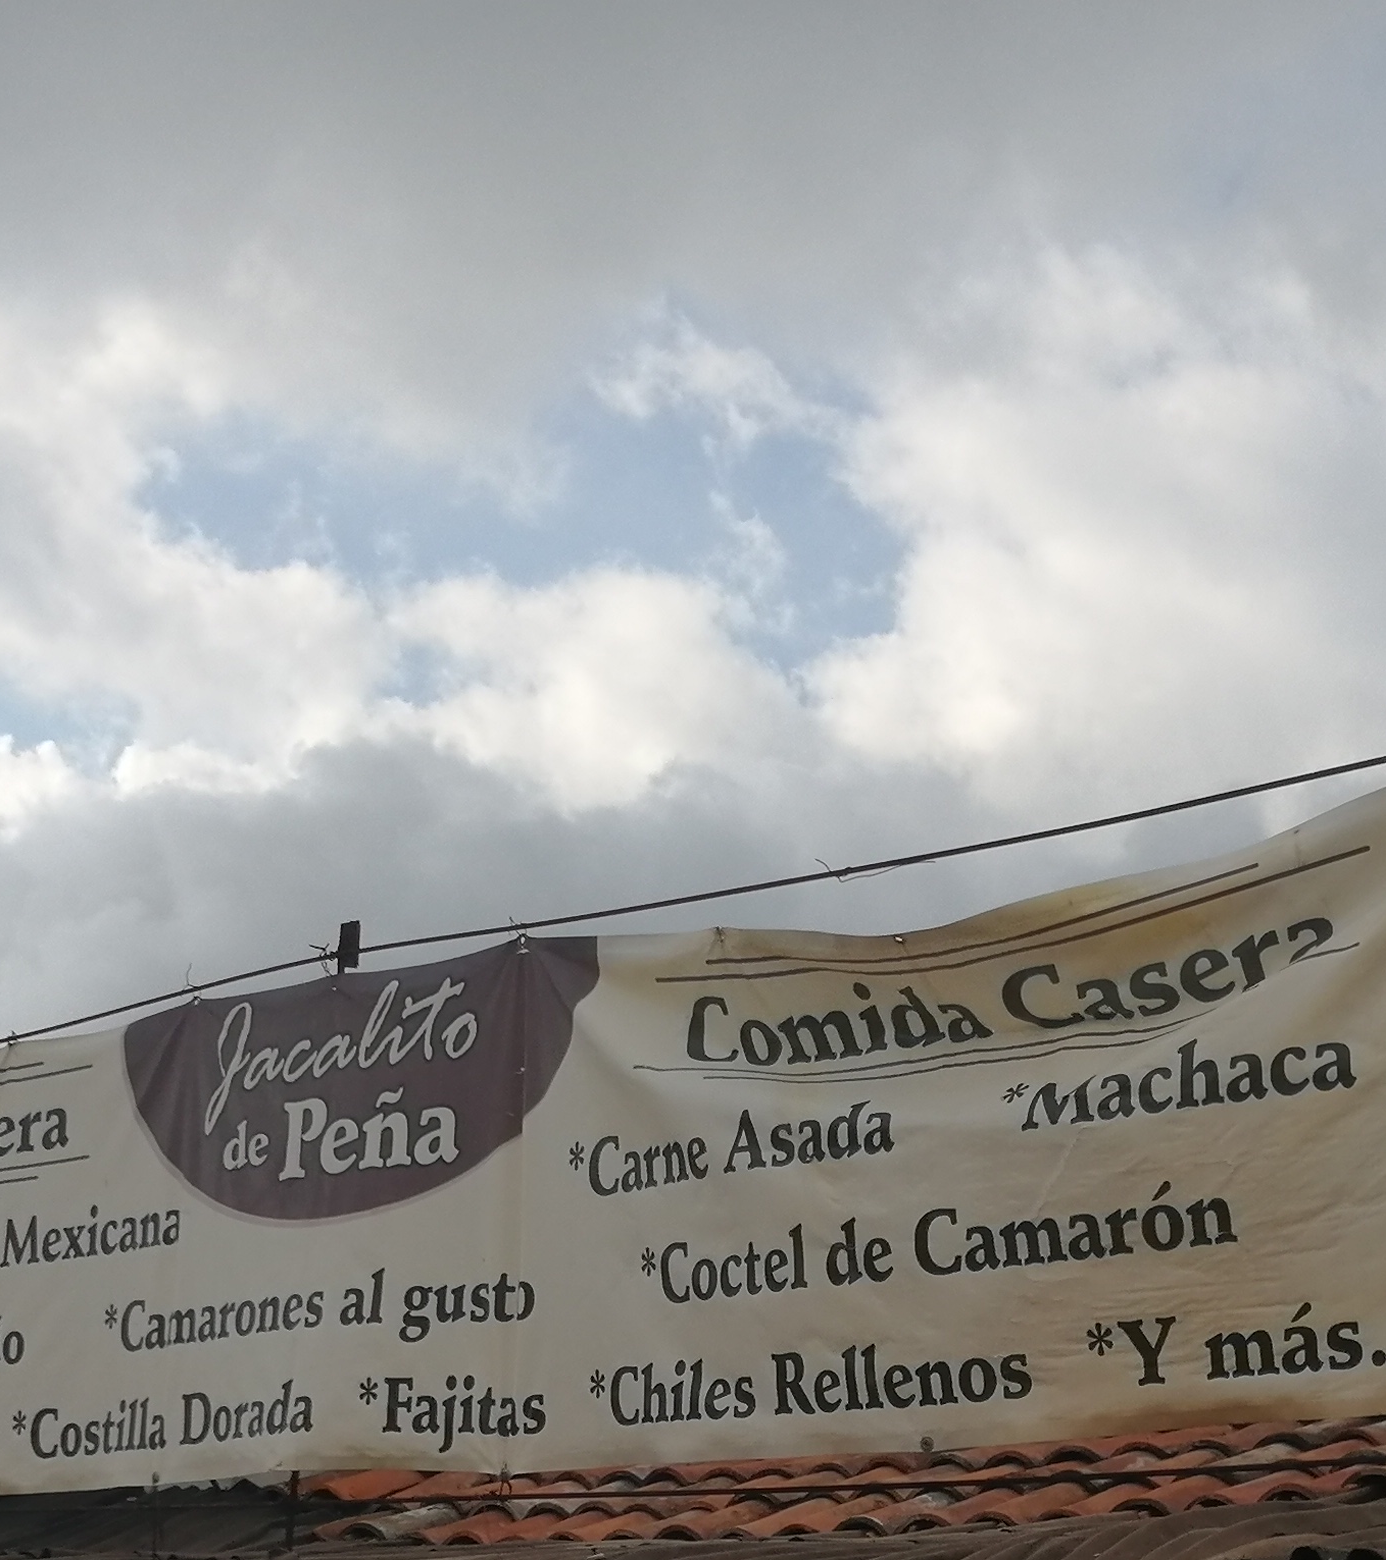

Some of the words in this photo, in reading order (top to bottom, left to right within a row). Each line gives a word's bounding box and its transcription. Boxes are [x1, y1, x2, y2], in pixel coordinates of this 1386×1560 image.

[204, 976, 479, 1136] Jacalito
[686, 981, 994, 1067] Comida
[222, 1120, 269, 1172] de
[278, 1085, 461, 1182] Peña
[723, 1100, 896, 1174] Asada
[0, 1204, 182, 1269] Mexicana
[825, 1216, 894, 1287] de
[914, 1180, 1239, 1276] Camarón
[339, 1267, 386, 1327] al
[179, 1378, 313, 1446] Dorada
[771, 1343, 1034, 1416] Rellenos
